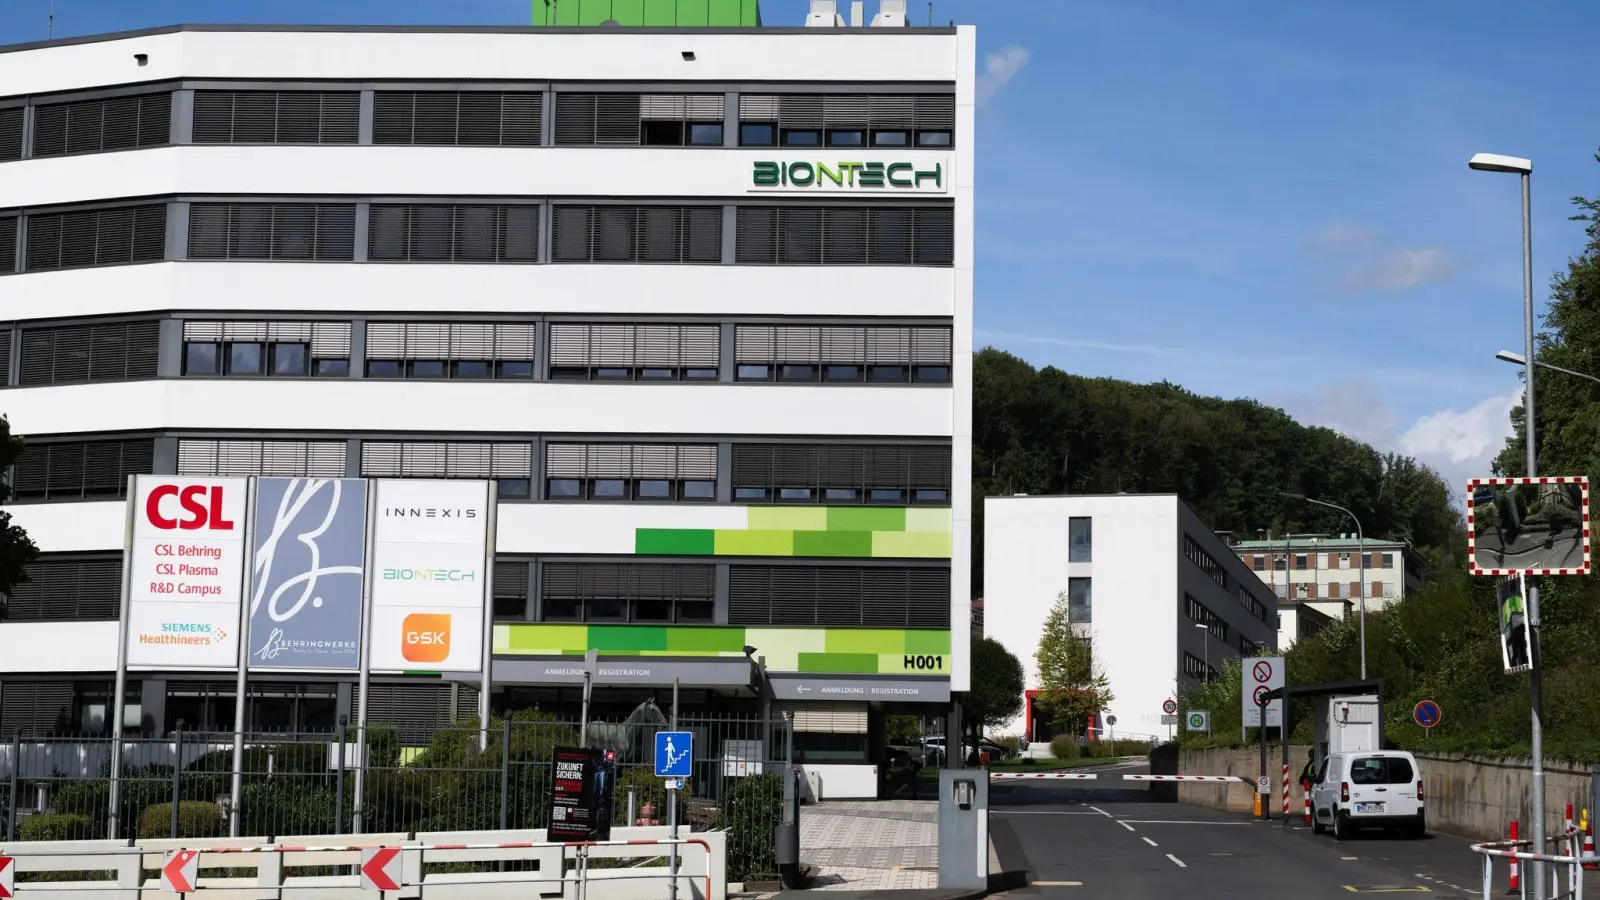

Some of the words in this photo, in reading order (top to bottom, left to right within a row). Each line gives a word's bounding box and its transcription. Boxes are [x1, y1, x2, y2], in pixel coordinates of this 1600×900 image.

[753, 161, 942, 188] BIONTECH
[146, 484, 234, 530] CSL
[385, 508, 476, 518] INNEXIS
[154, 544, 175, 556] CSL
[178, 545, 222, 560] Behring
[156, 564, 176, 575] CSL
[179, 564, 218, 576] Plasma
[383, 568, 475, 581] BIONTECH
[150, 582, 174, 593] R&D
[178, 583, 221, 597] Campus
[161, 622, 211, 632] SIEMENS
[139, 634, 211, 645] Healthineers
[406, 631, 446, 645] GSK
[281, 640, 356, 648] BEHRINGWERKE
[904, 655, 942, 670] H001
[544, 668, 586, 676] ANMELDUN
[598, 668, 650, 676] REGISTRATION
[821, 687, 864, 695] ANMELDUNG
[871, 687, 919, 696] REGISTRATION
[1165, 703, 1174, 711] 30
[1193, 716, 1200, 725] H
[556, 762, 584, 771] ZUKUNFT
[556, 771, 583, 780] SICHERN:
